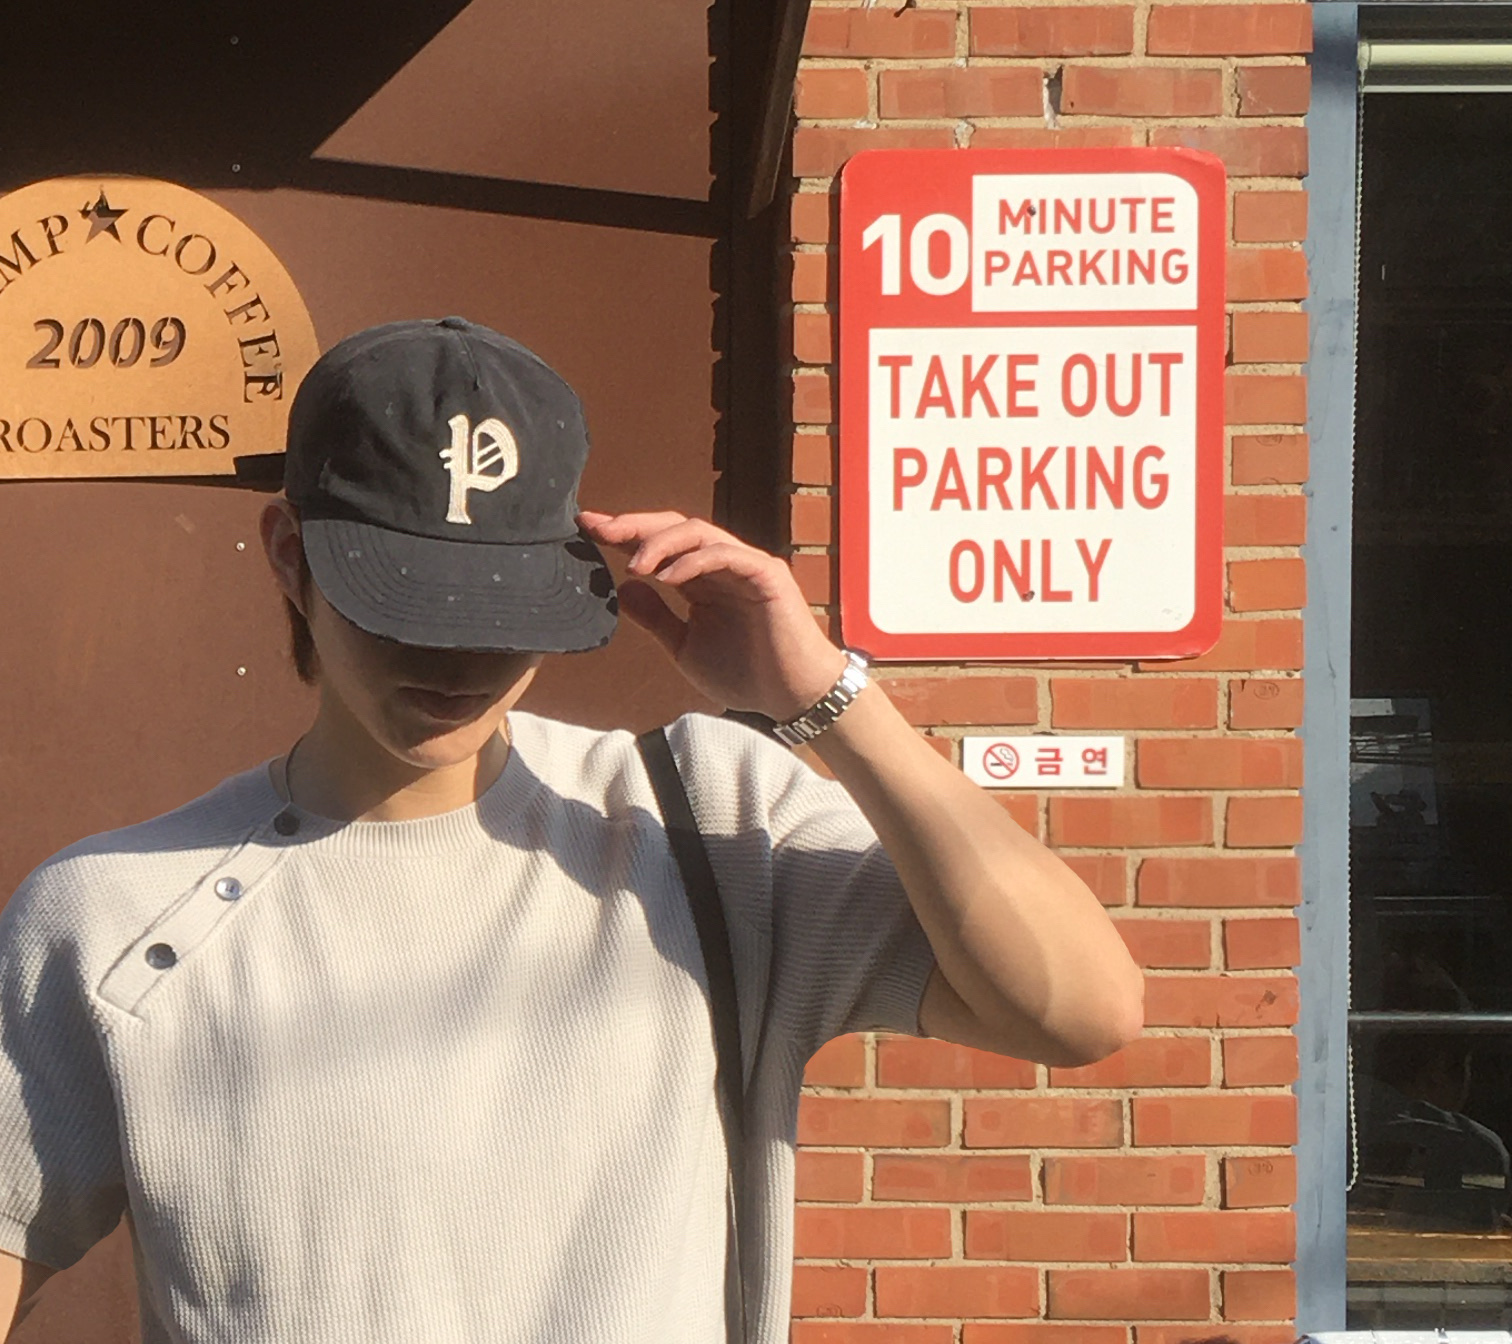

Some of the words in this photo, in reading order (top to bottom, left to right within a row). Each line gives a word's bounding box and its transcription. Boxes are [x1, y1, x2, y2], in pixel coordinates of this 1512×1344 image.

[998, 197, 1175, 235] MINUTE
[862, 213, 970, 296] 10
[984, 248, 1189, 287] PARKING
[135, 214, 283, 404] COFFEE
[25, 316, 187, 369] 2009
[878, 354, 1039, 419] TAKE
[1060, 352, 1184, 417] OUT
[892, 445, 1170, 512] PARKING
[949, 538, 1113, 604] ONLY
